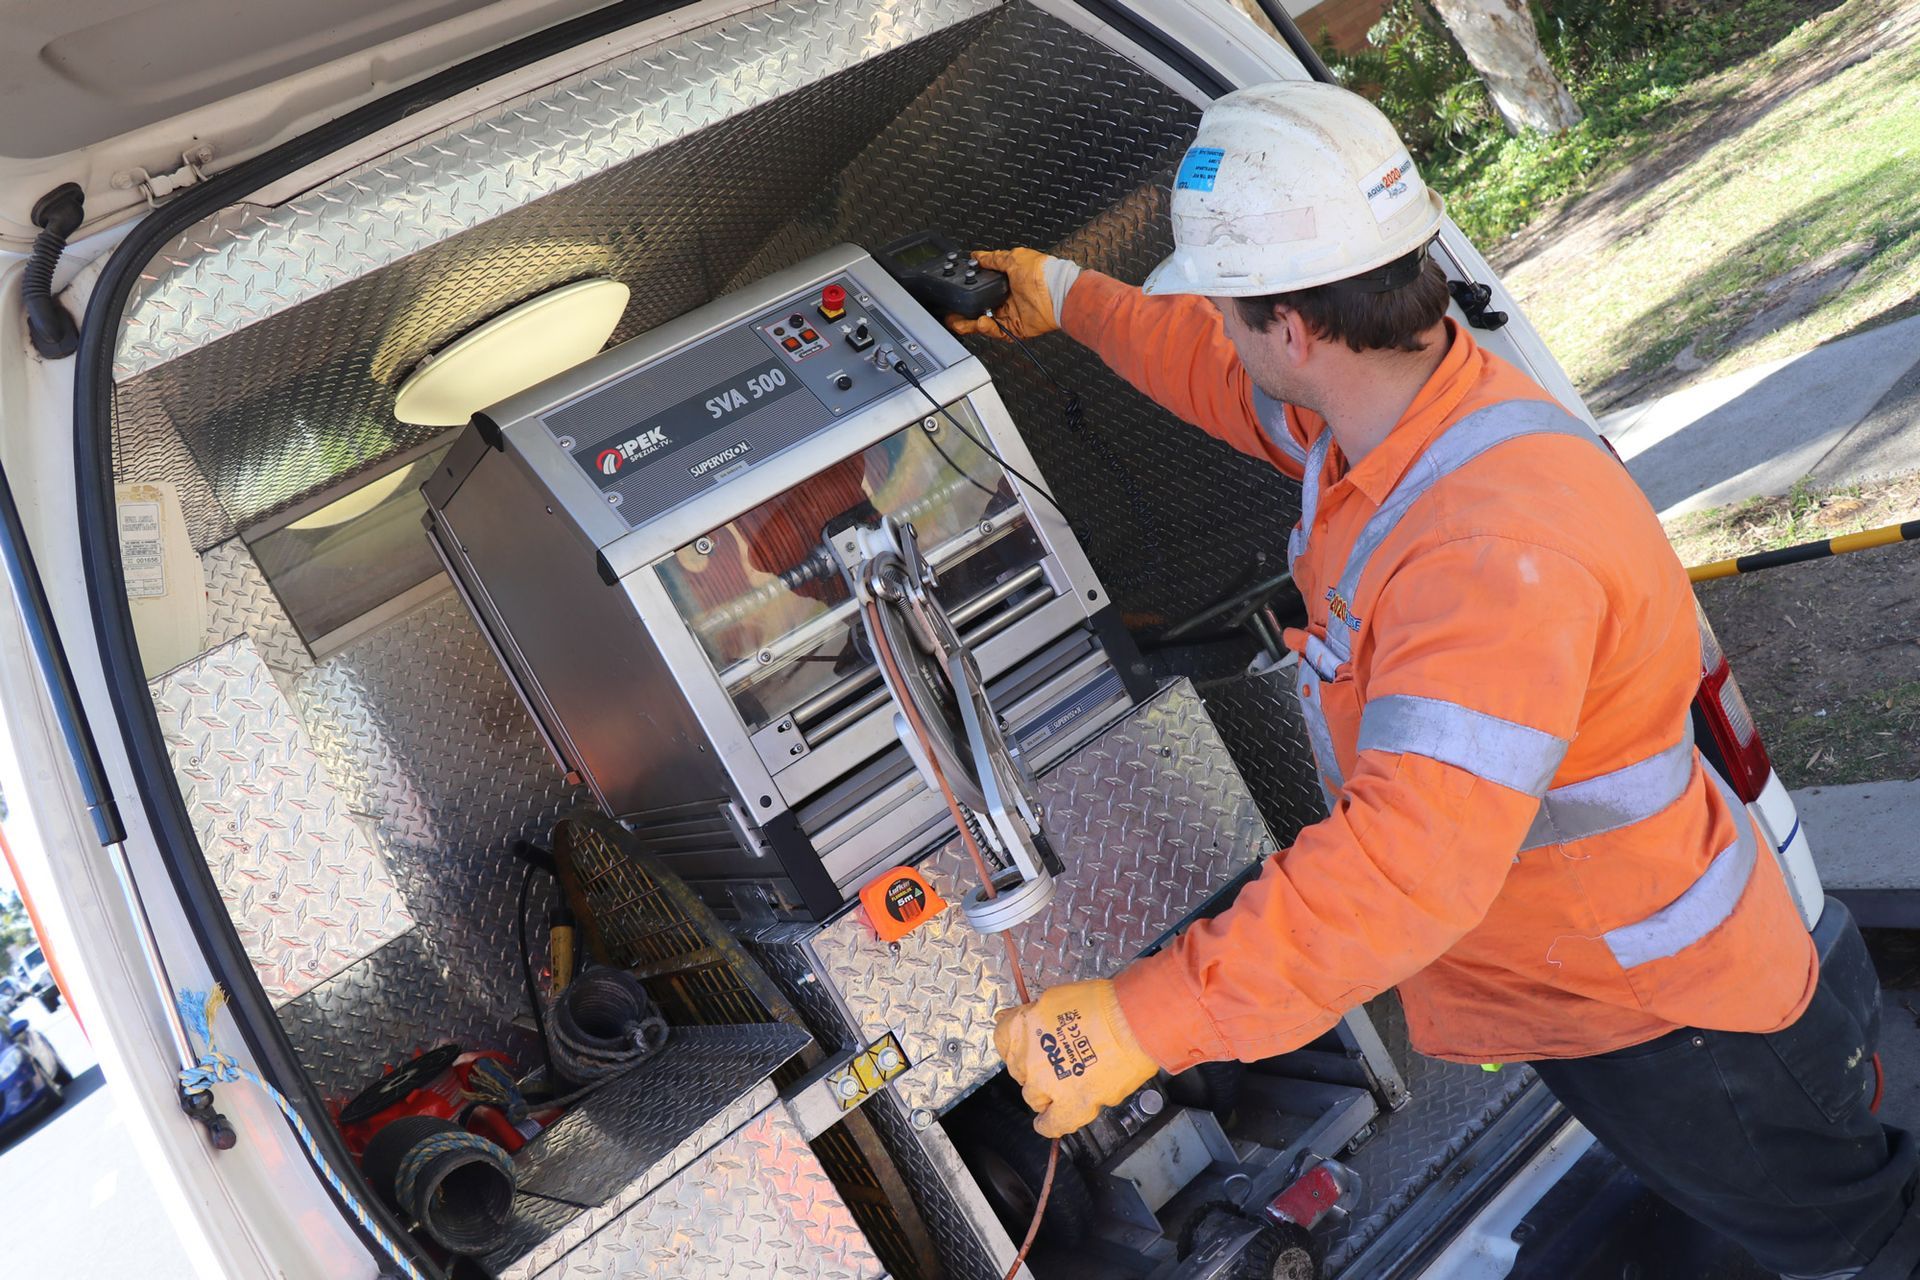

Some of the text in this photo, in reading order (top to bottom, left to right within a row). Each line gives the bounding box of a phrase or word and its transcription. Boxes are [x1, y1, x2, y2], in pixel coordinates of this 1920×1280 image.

[1367, 183, 1385, 198] AQUA
[1382, 167, 1402, 188] 2020
[705, 368, 786, 419] SVA 500
[615, 426, 668, 460] iPEK
[690, 441, 748, 477] SUPERVISION
[897, 894, 914, 907] 5m
[1056, 1026, 1066, 1042] Lite
[1067, 1023, 1081, 1038] CE
[1040, 1033, 1072, 1080] PRO
[1062, 1042, 1077, 1063] Super
[1077, 1040, 1090, 1055] 10
